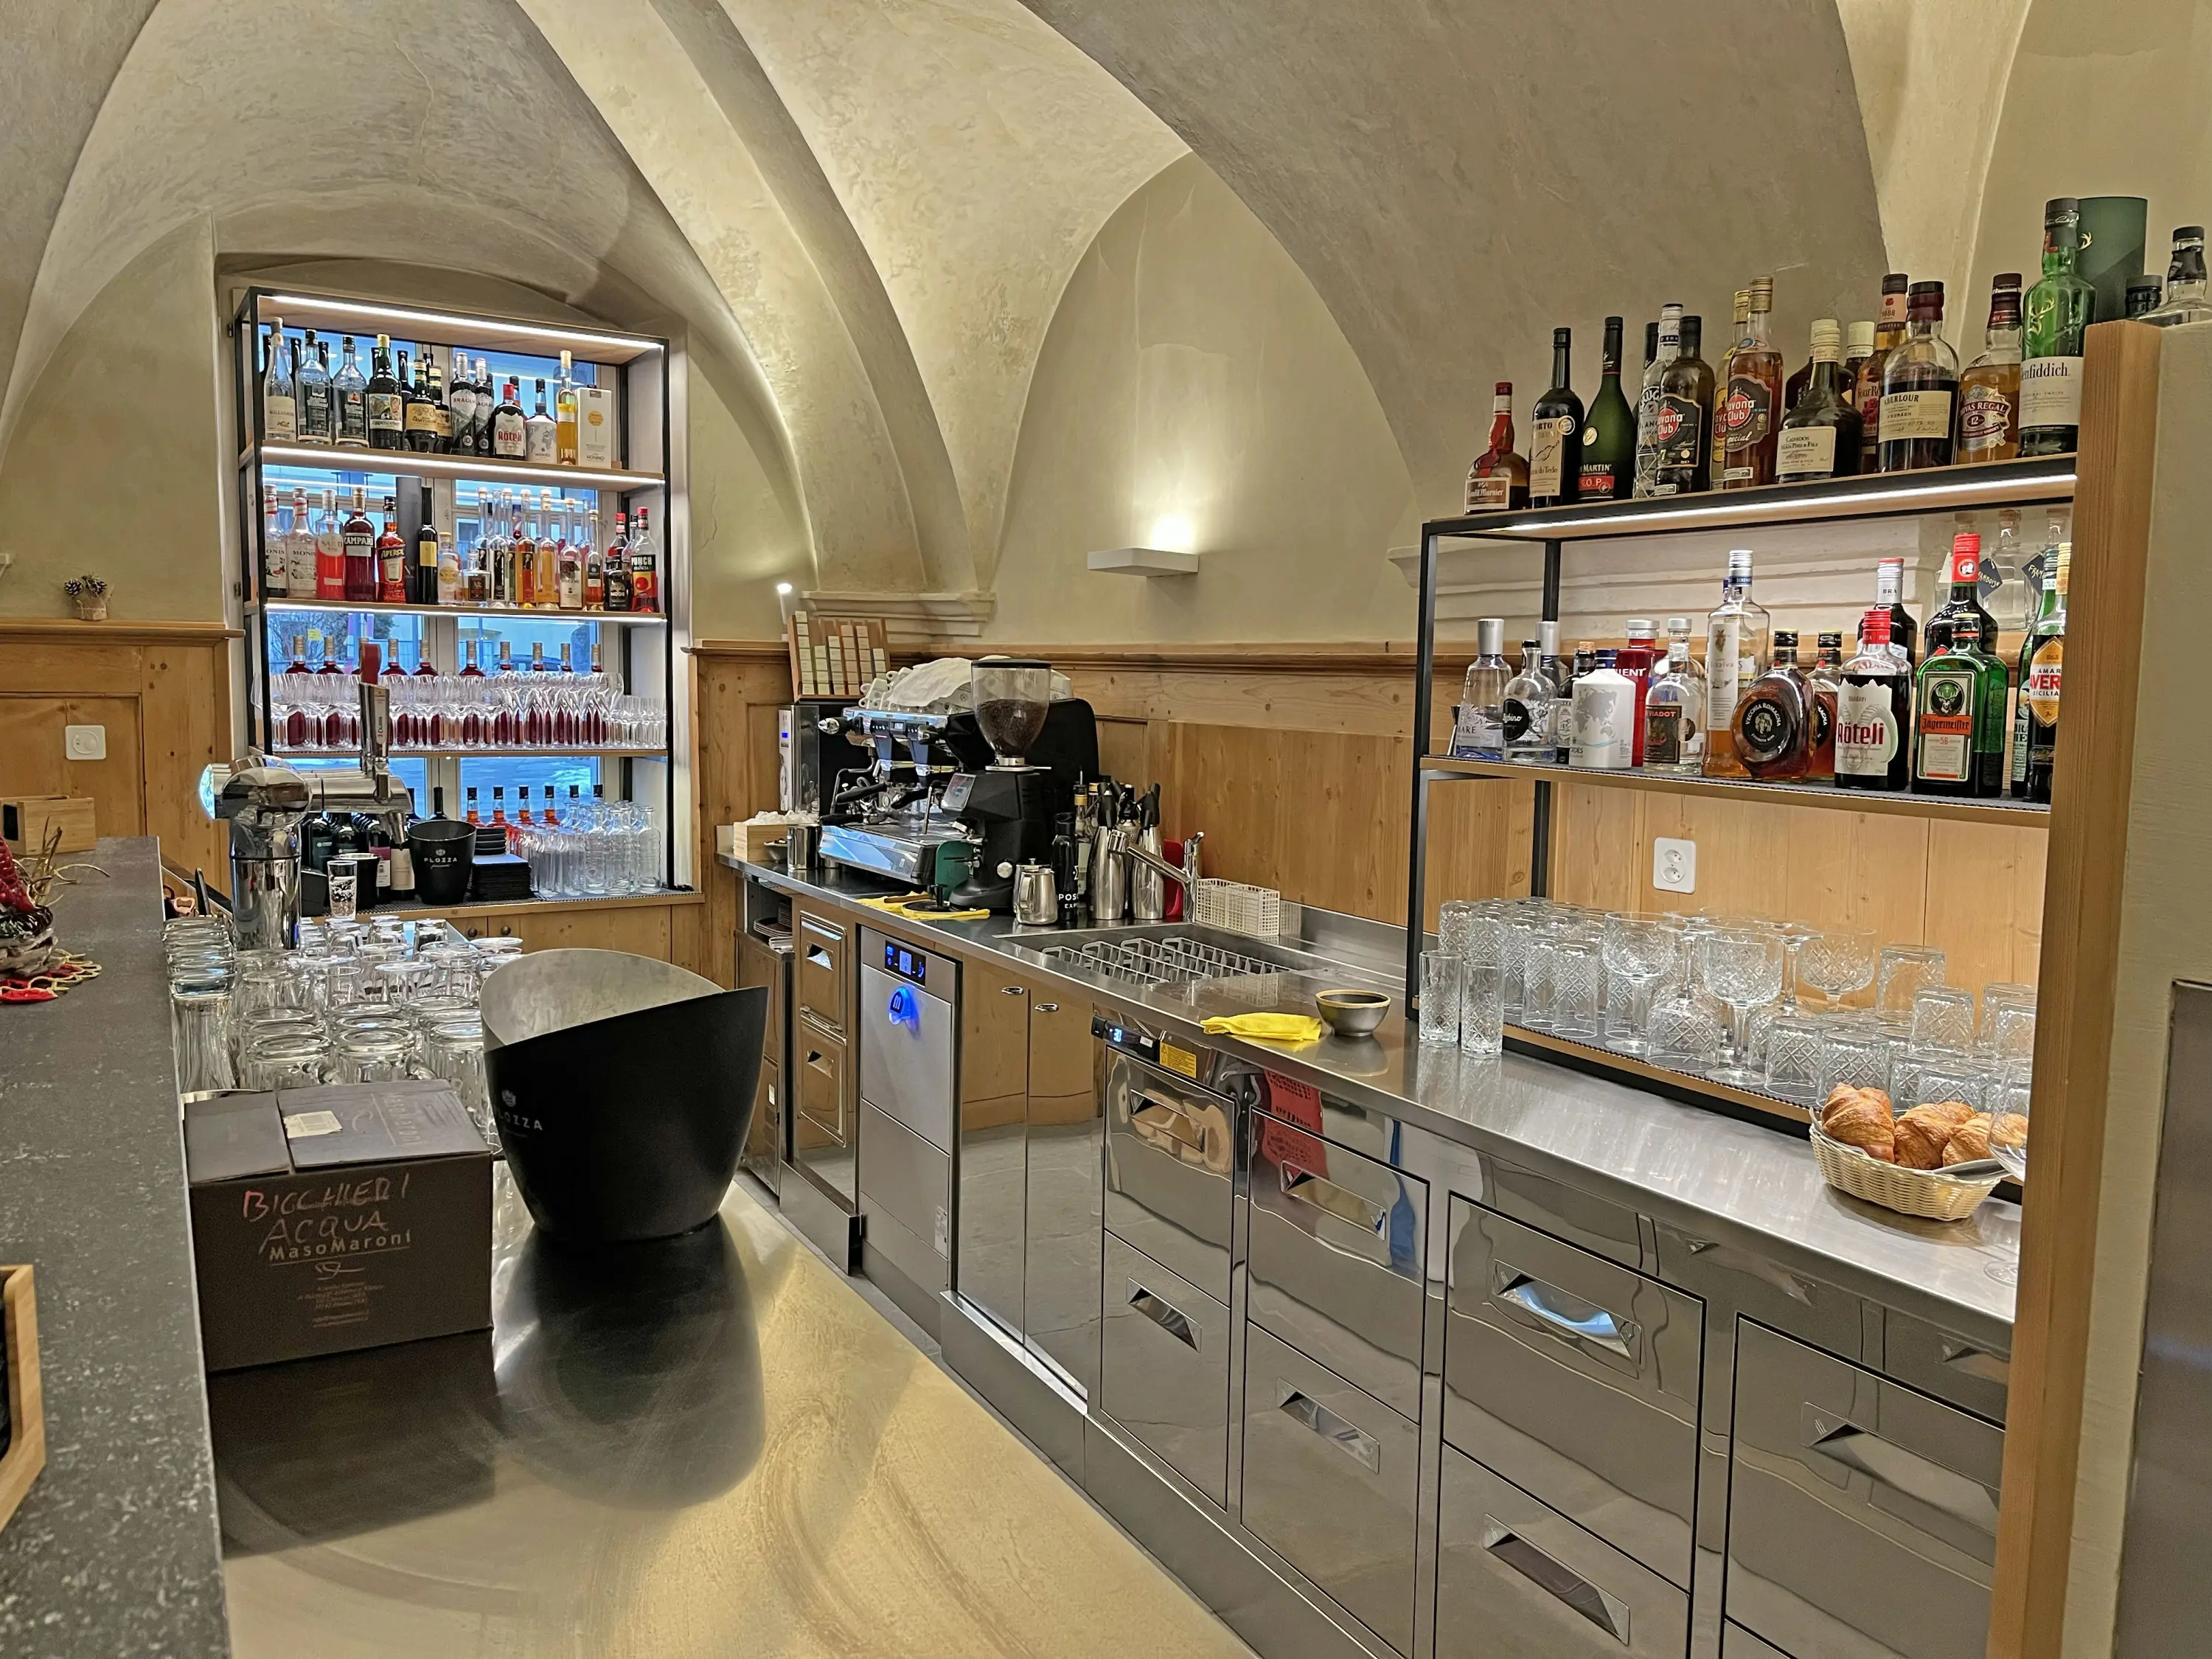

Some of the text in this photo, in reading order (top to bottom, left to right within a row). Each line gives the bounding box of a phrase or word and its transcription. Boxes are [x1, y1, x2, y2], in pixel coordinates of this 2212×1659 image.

[1728, 399, 1755, 409] avana
[1885, 394, 1919, 405] ABERLOUR
[1977, 401, 2006, 413] REGAL
[1658, 414, 1683, 425] avana
[1728, 410, 1745, 420] Club
[1971, 416, 1979, 425] 12
[1582, 464, 1610, 472] MARTIN
[344, 536, 374, 546] CAMPARI
[380, 548, 404, 557] APEROL
[2030, 674, 2061, 690] AVER
[1745, 703, 1762, 725] VECCHIA
[1762, 702, 1781, 726] ROMAGNA
[1837, 722, 1885, 745] Röteli
[498, 1107, 543, 1132] LOZZA
[258, 1210, 389, 1254] ACQUA
